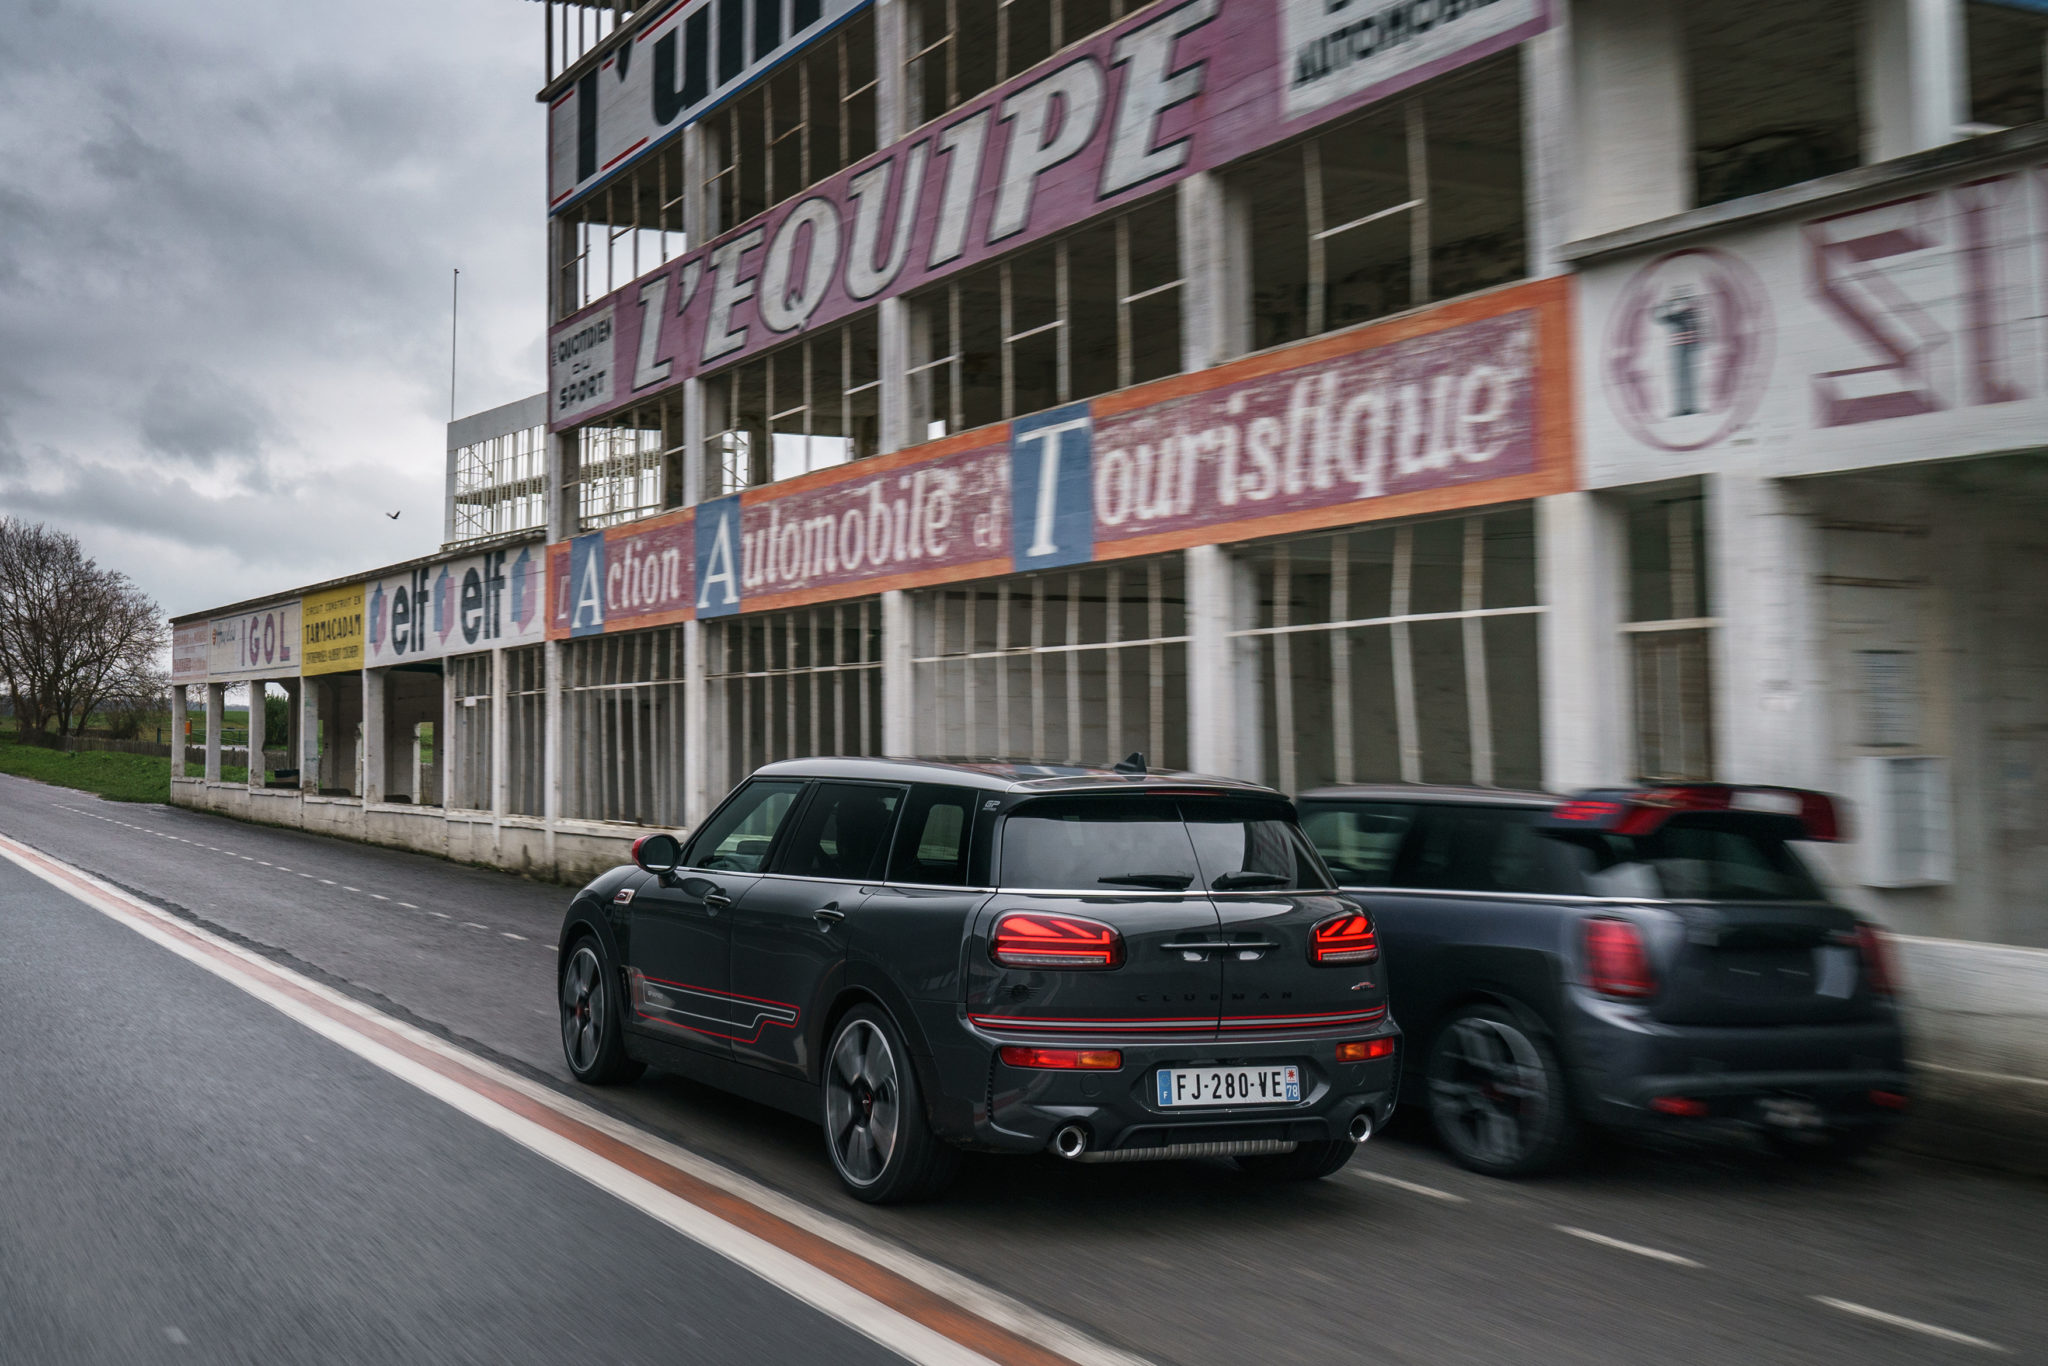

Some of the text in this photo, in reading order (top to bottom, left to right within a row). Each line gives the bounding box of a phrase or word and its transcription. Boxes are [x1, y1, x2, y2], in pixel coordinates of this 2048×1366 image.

[560, 370, 606, 410] SPORT
[697, 468, 952, 609] Automobile
[1015, 364, 1512, 557] Touristique
[392, 551, 506, 656] elf elf
[242, 612, 290, 667] IGOL
[306, 614, 361, 645] TARMACADAM
[1135, 991, 1293, 1003] CLUBMAN
[1163, 1071, 1299, 1101] F FJ-280-VE 78
